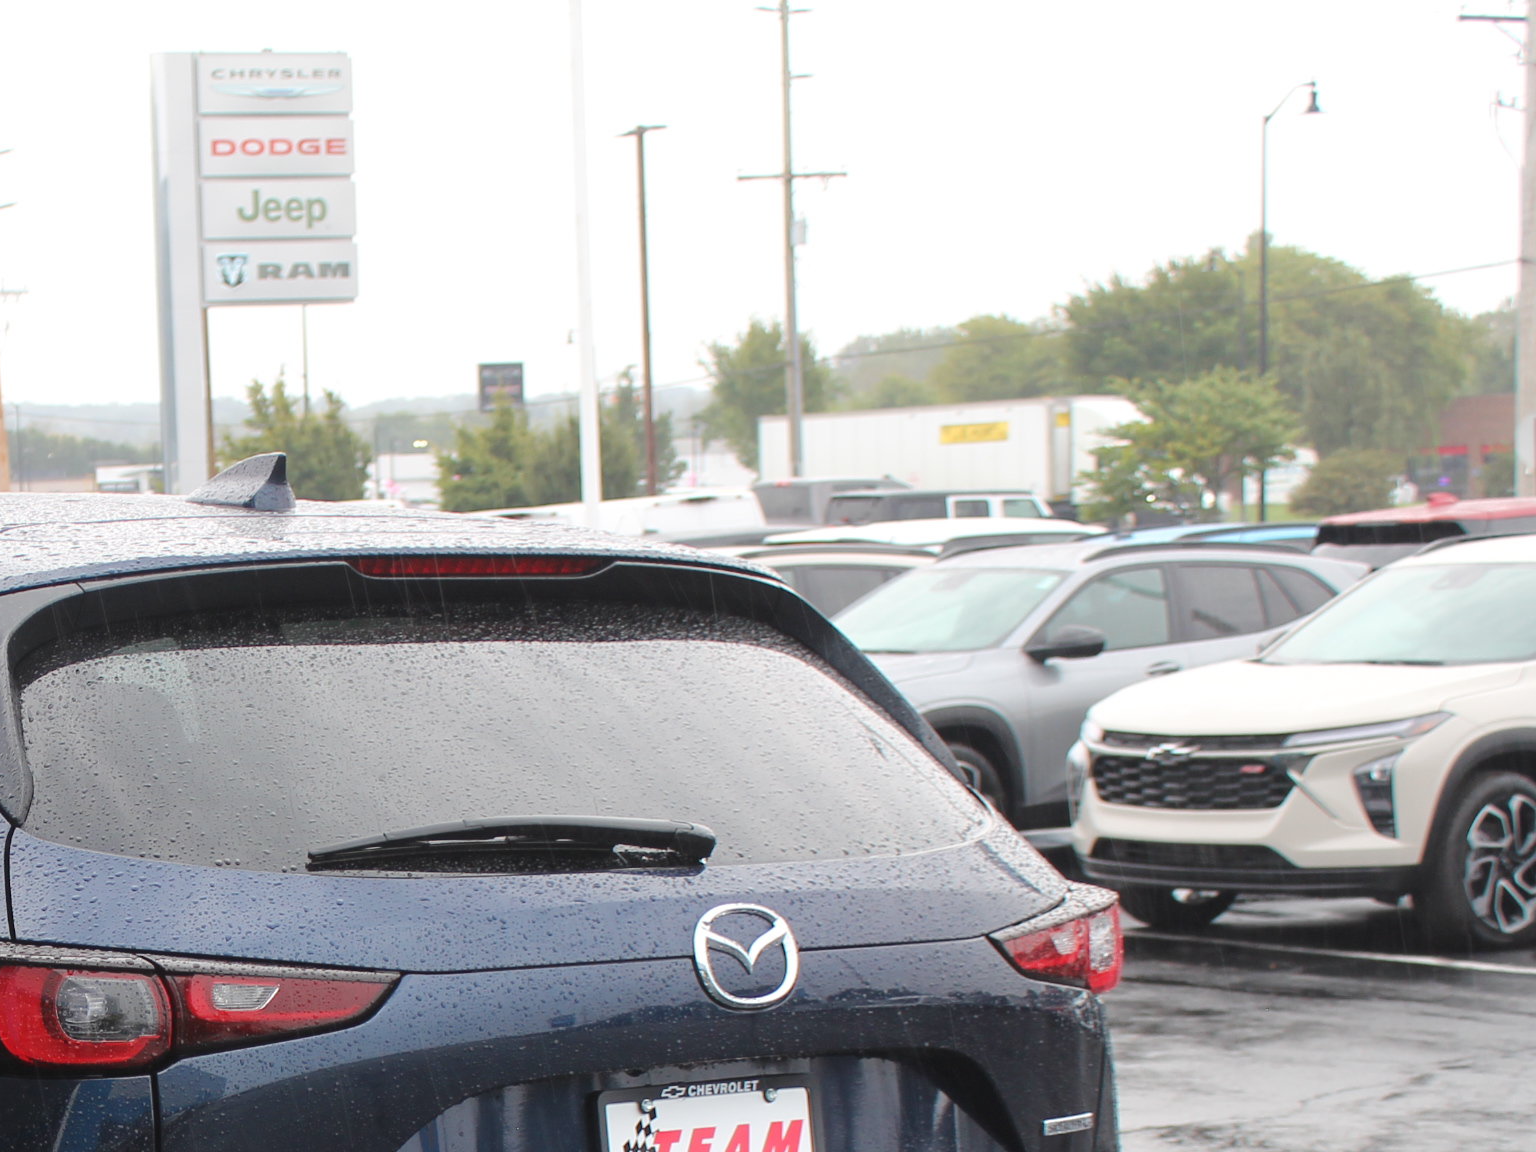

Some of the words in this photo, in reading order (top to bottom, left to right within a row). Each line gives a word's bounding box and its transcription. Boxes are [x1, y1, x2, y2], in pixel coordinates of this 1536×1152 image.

[210, 68, 342, 80] CHRYSLER
[210, 138, 347, 156] DODGE
[237, 189, 327, 229] Jeep
[257, 262, 351, 279] RAM
[688, 1080, 759, 1096] CHEVROLET
